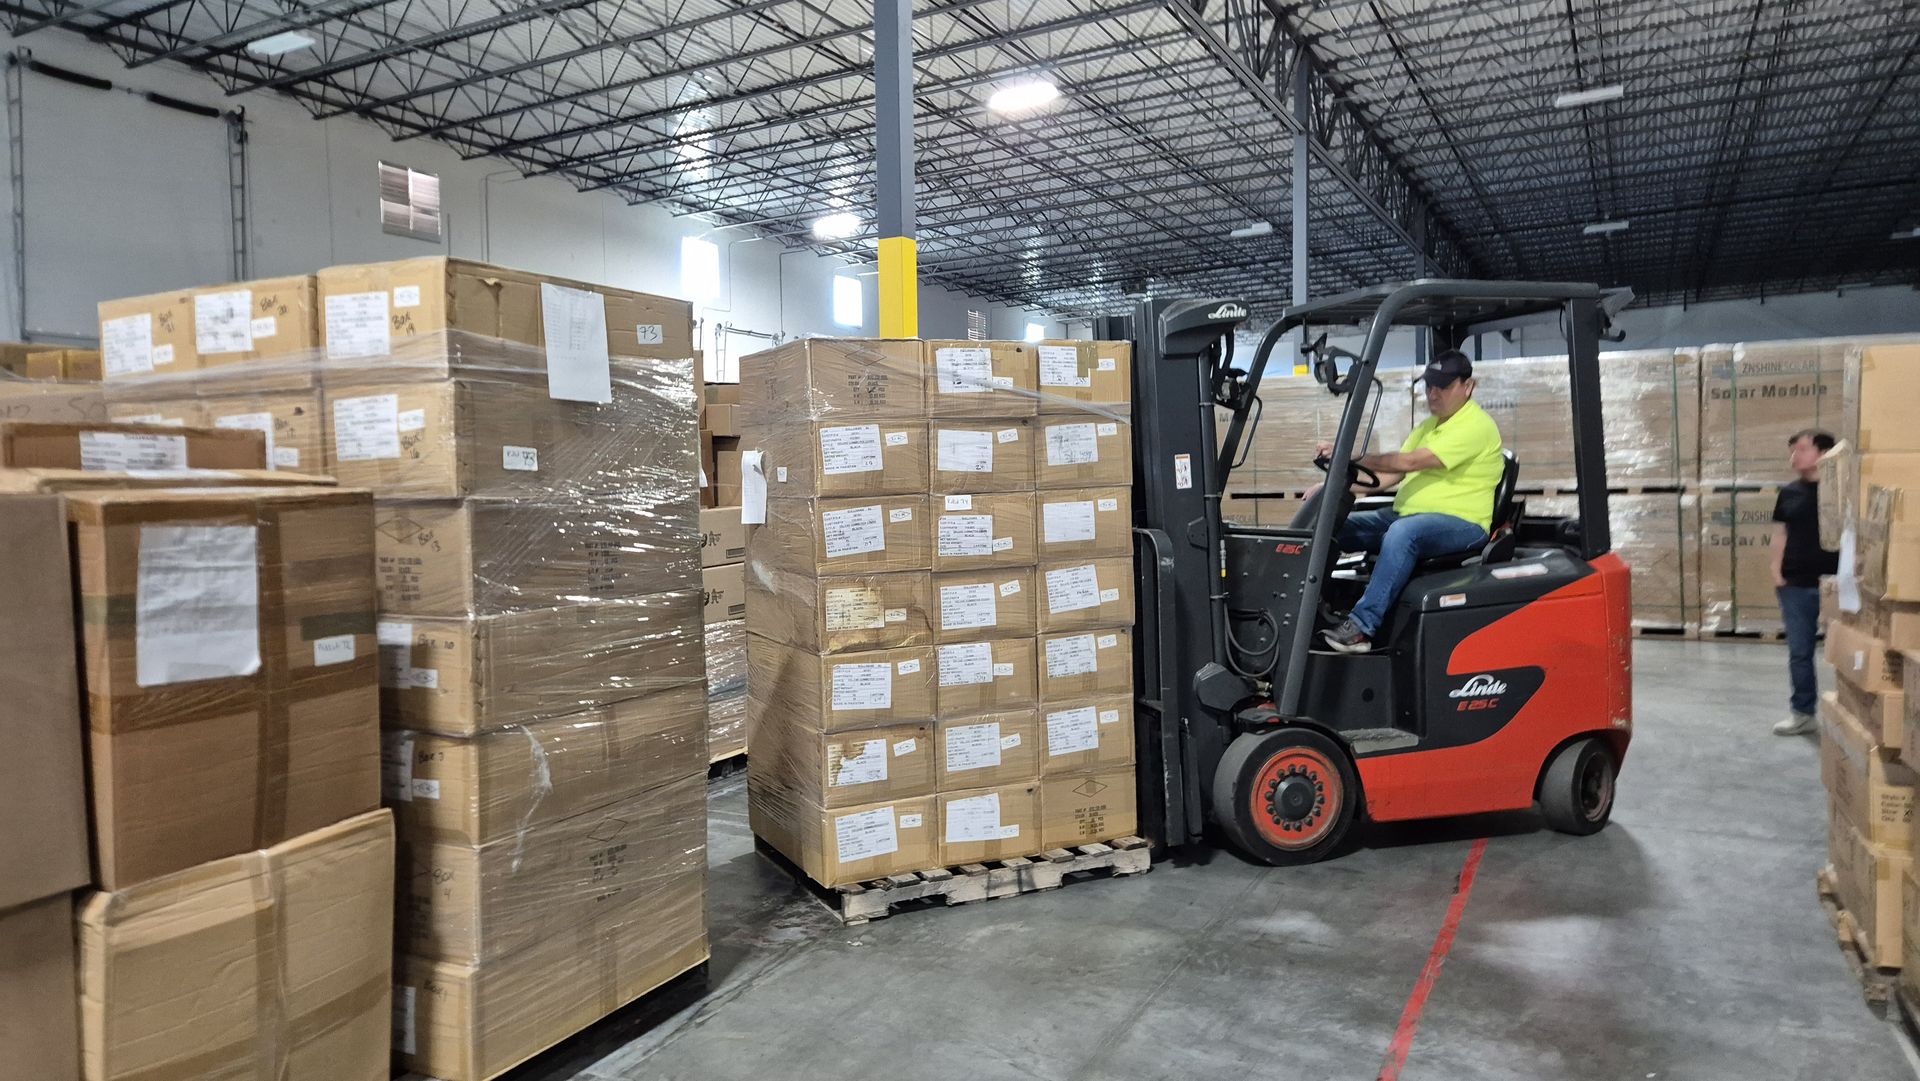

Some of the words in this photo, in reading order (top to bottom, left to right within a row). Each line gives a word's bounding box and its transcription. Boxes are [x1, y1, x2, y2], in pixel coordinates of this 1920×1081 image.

[1208, 303, 1247, 319] Linde
[639, 325, 658, 341] 73
[1711, 386, 1756, 400] Solar
[1761, 383, 1828, 398] Module
[1711, 534, 1755, 547] Soar
[1449, 674, 1508, 698] Linde
